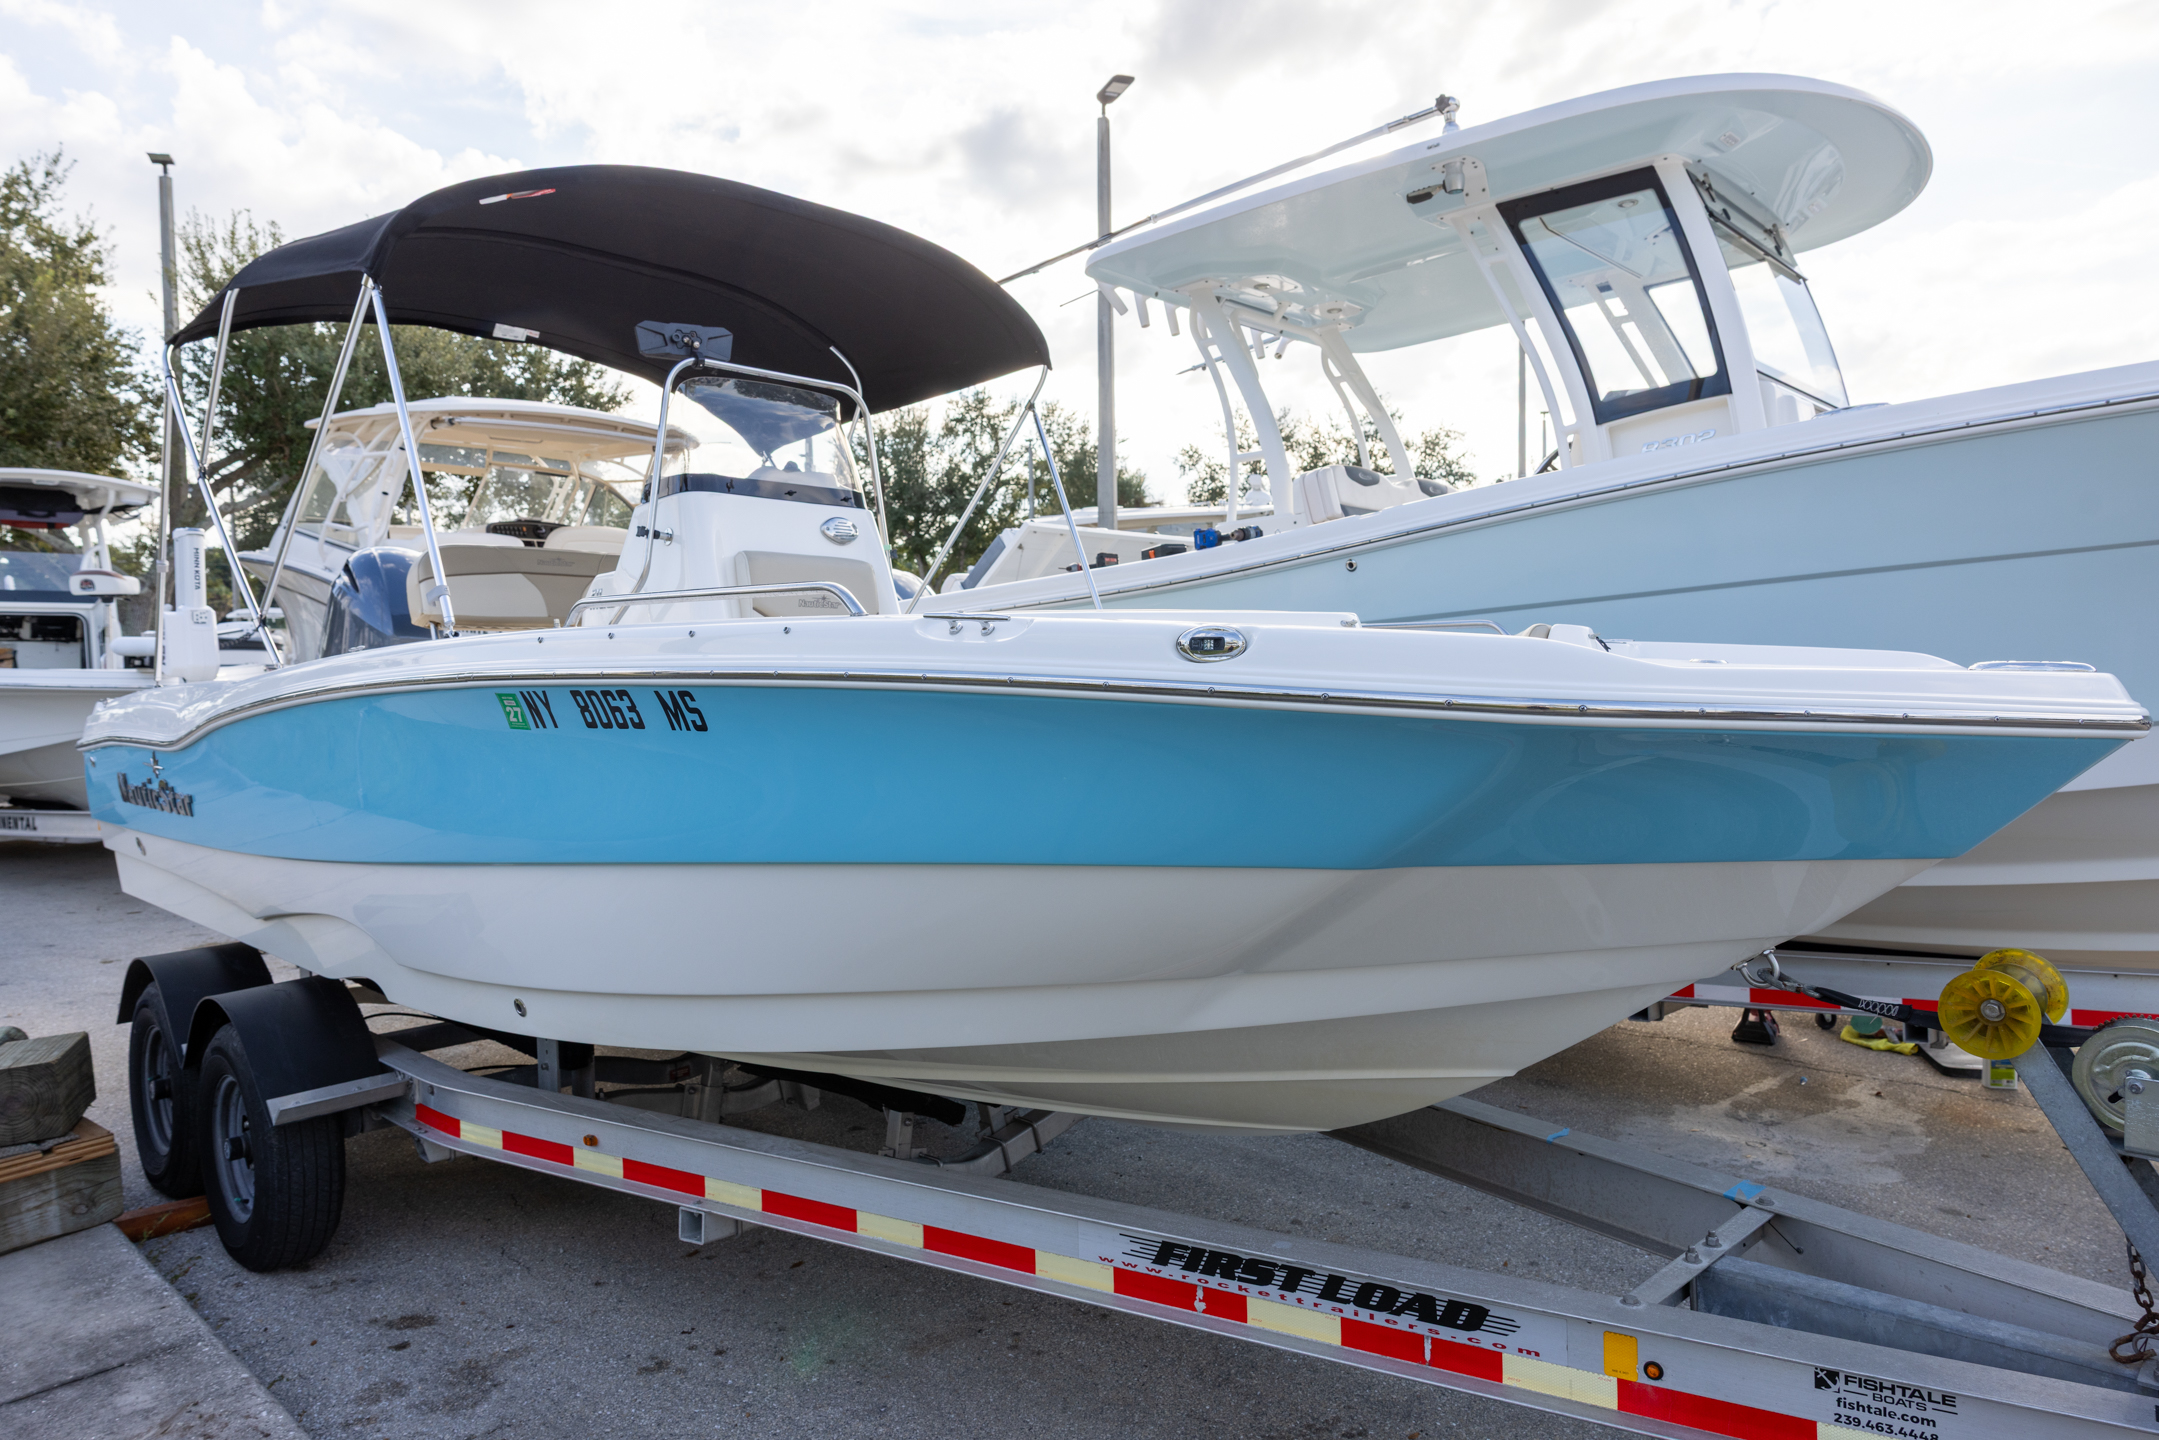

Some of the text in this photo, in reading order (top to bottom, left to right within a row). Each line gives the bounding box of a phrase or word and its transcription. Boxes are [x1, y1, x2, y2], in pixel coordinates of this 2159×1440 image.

[505, 706, 523, 722] 27
[519, 689, 709, 732] NY 8063 MS
[117, 772, 194, 817] NauticStar
[1152, 1240, 1491, 1332] FIRST LOAD
[1098, 1256, 1541, 1357] www.rockettrailers.com
[1843, 1374, 1957, 1408] FISHTALE
[1872, 1392, 1927, 1412] BOATS
[1833, 1412, 1939, 1440] 239.463.4448
[1836, 1397, 1937, 1428] fishtale.com
